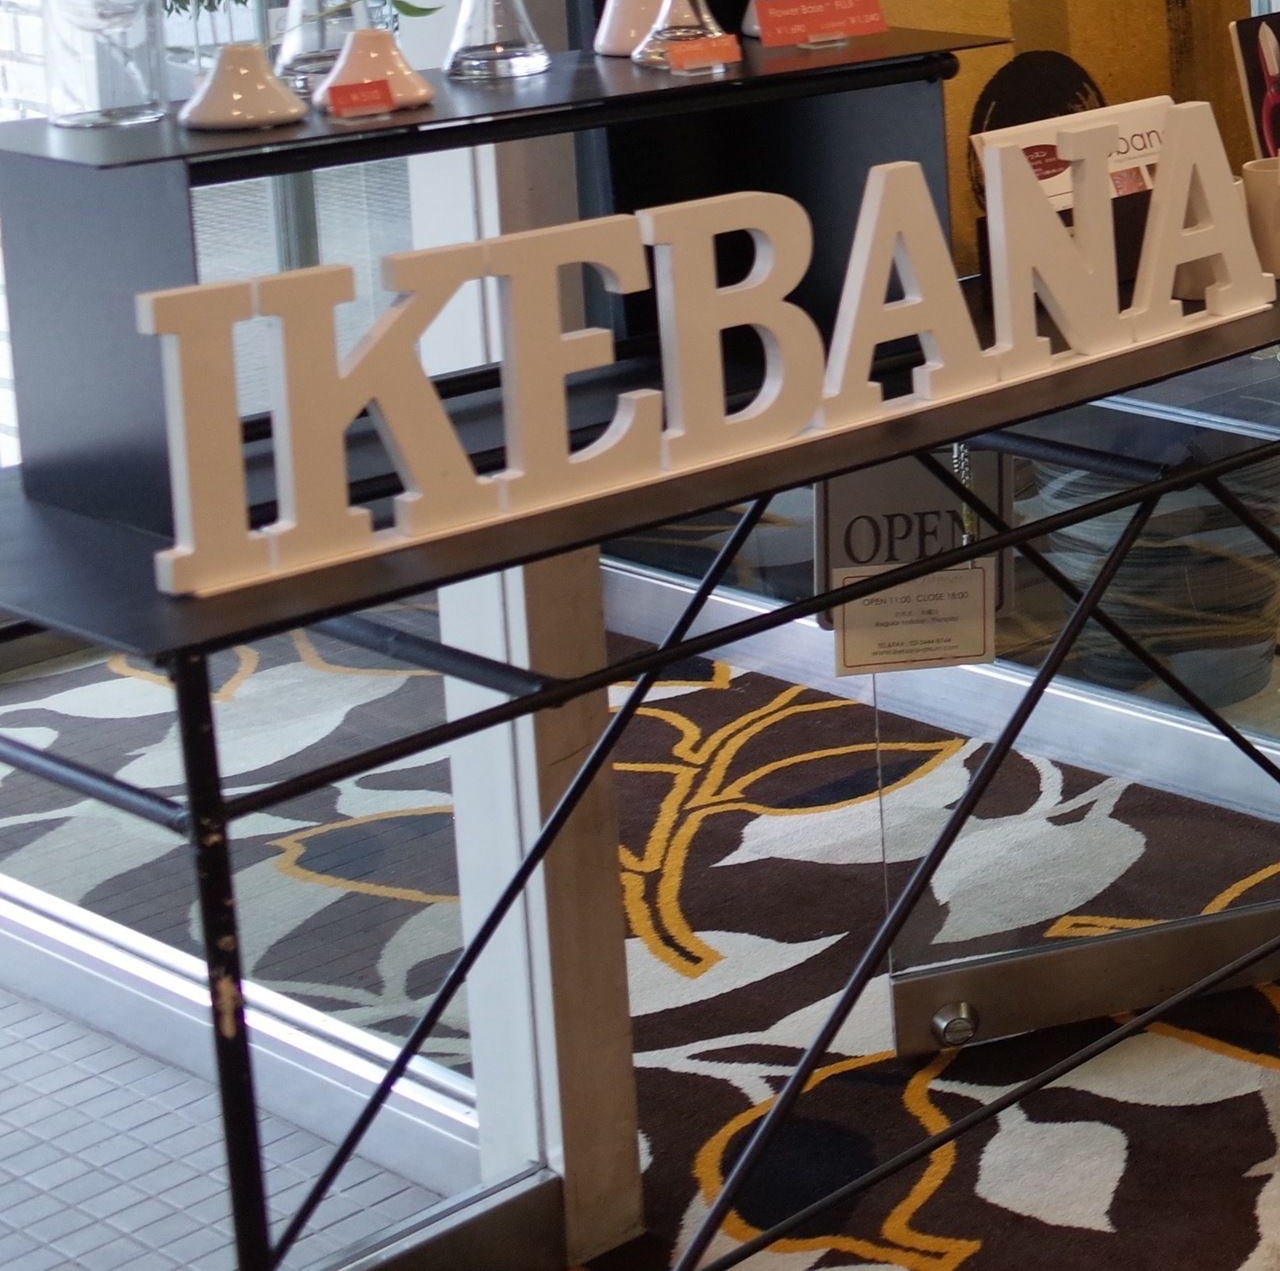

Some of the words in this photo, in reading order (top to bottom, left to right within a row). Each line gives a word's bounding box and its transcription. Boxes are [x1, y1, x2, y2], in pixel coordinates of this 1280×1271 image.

[136, 100, 1274, 596] IKEBANA
[844, 511, 980, 564] OPEN
[863, 598, 887, 607] OPEN
[889, 595, 911, 604] 11:00
[916, 593, 944, 603] CLOSE
